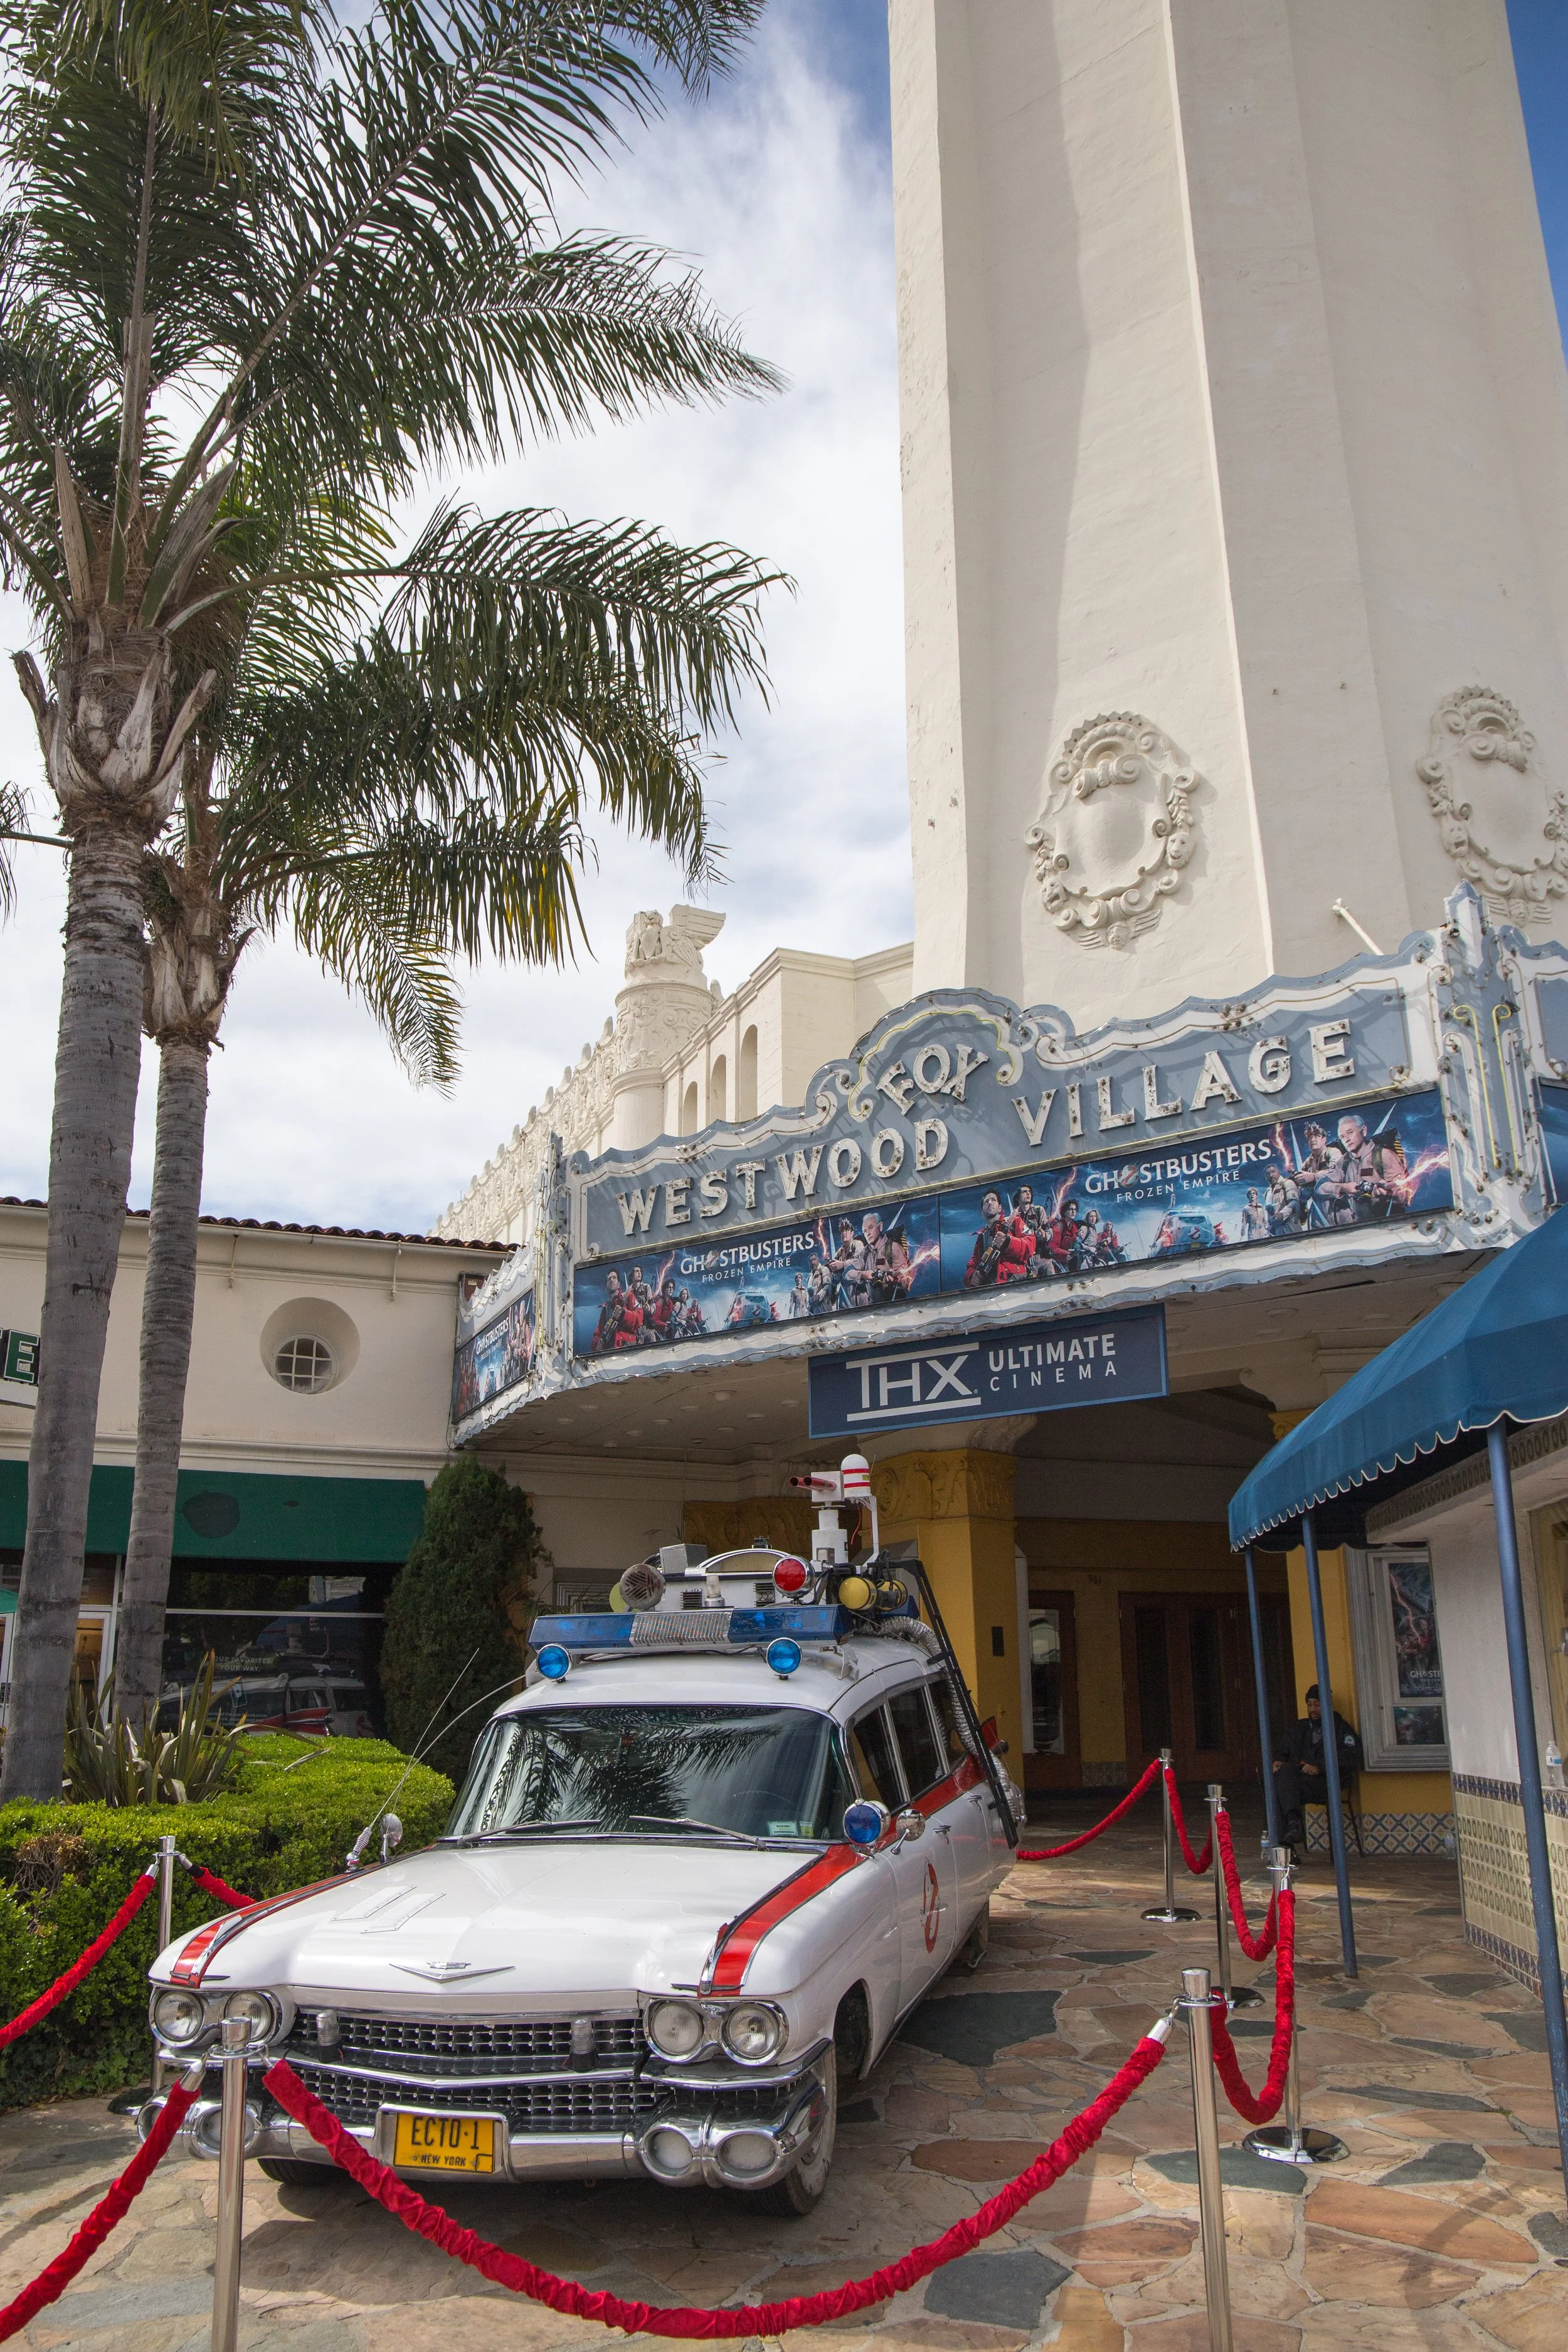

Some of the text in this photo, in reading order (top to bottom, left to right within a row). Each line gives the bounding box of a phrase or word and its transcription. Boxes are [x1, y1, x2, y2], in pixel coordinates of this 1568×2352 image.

[877, 1044, 988, 1116] FOX
[1011, 1019, 1355, 1147] VILLAGE
[616, 1118, 948, 1236] WESTWOOD
[1085, 1139, 1273, 1194] GHOSTBUSTERS
[1116, 1170, 1240, 1203] FROZEN EMPIRE
[681, 1231, 815, 1274] GHOSTBUSTERS
[702, 1258, 791, 1283] FROZEN EMPIRE
[989, 1333, 1116, 1372] ULTIMATE
[990, 1360, 1117, 1391] CINEMA
[421, 2154, 466, 2166] NEW YORK
